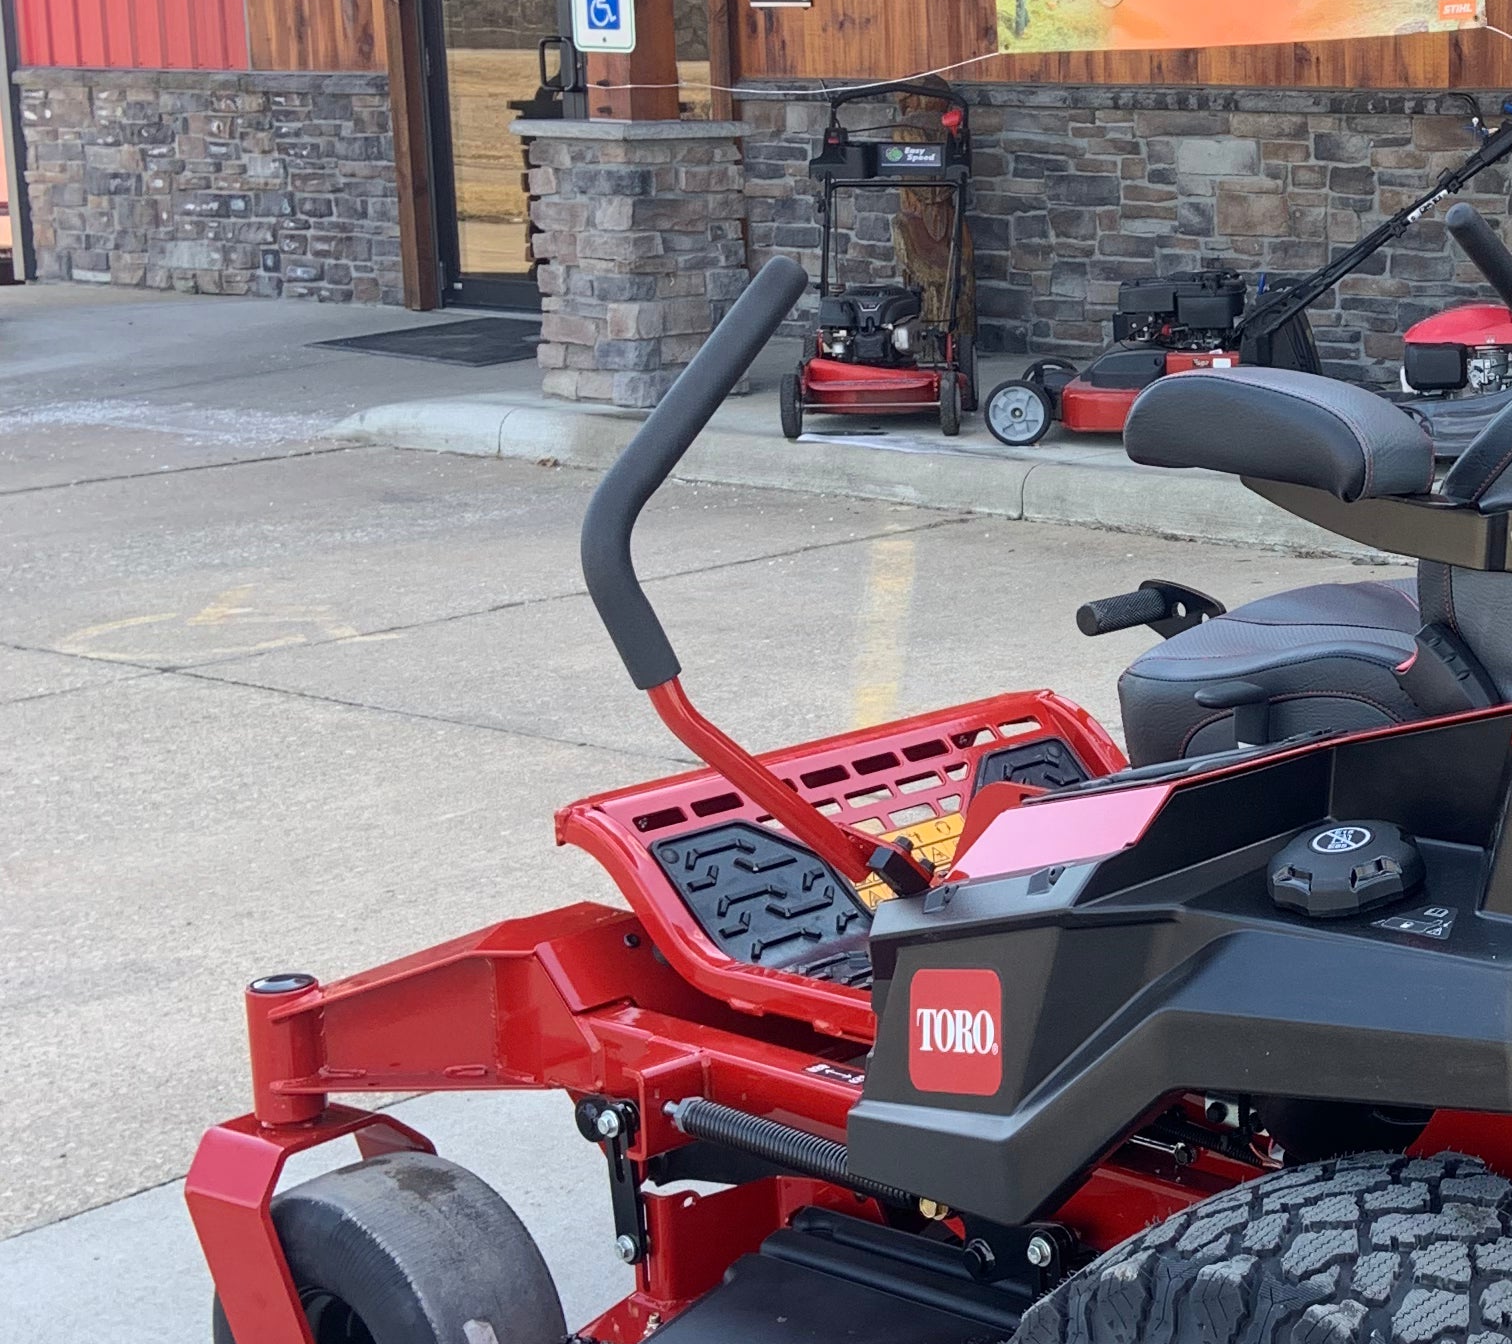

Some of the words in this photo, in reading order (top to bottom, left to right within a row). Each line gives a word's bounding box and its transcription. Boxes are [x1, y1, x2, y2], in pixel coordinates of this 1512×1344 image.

[1443, 3, 1472, 15] STIHL
[904, 146, 925, 156] Easy
[907, 153, 935, 163] Speed
[916, 1006, 995, 1055] TORO
